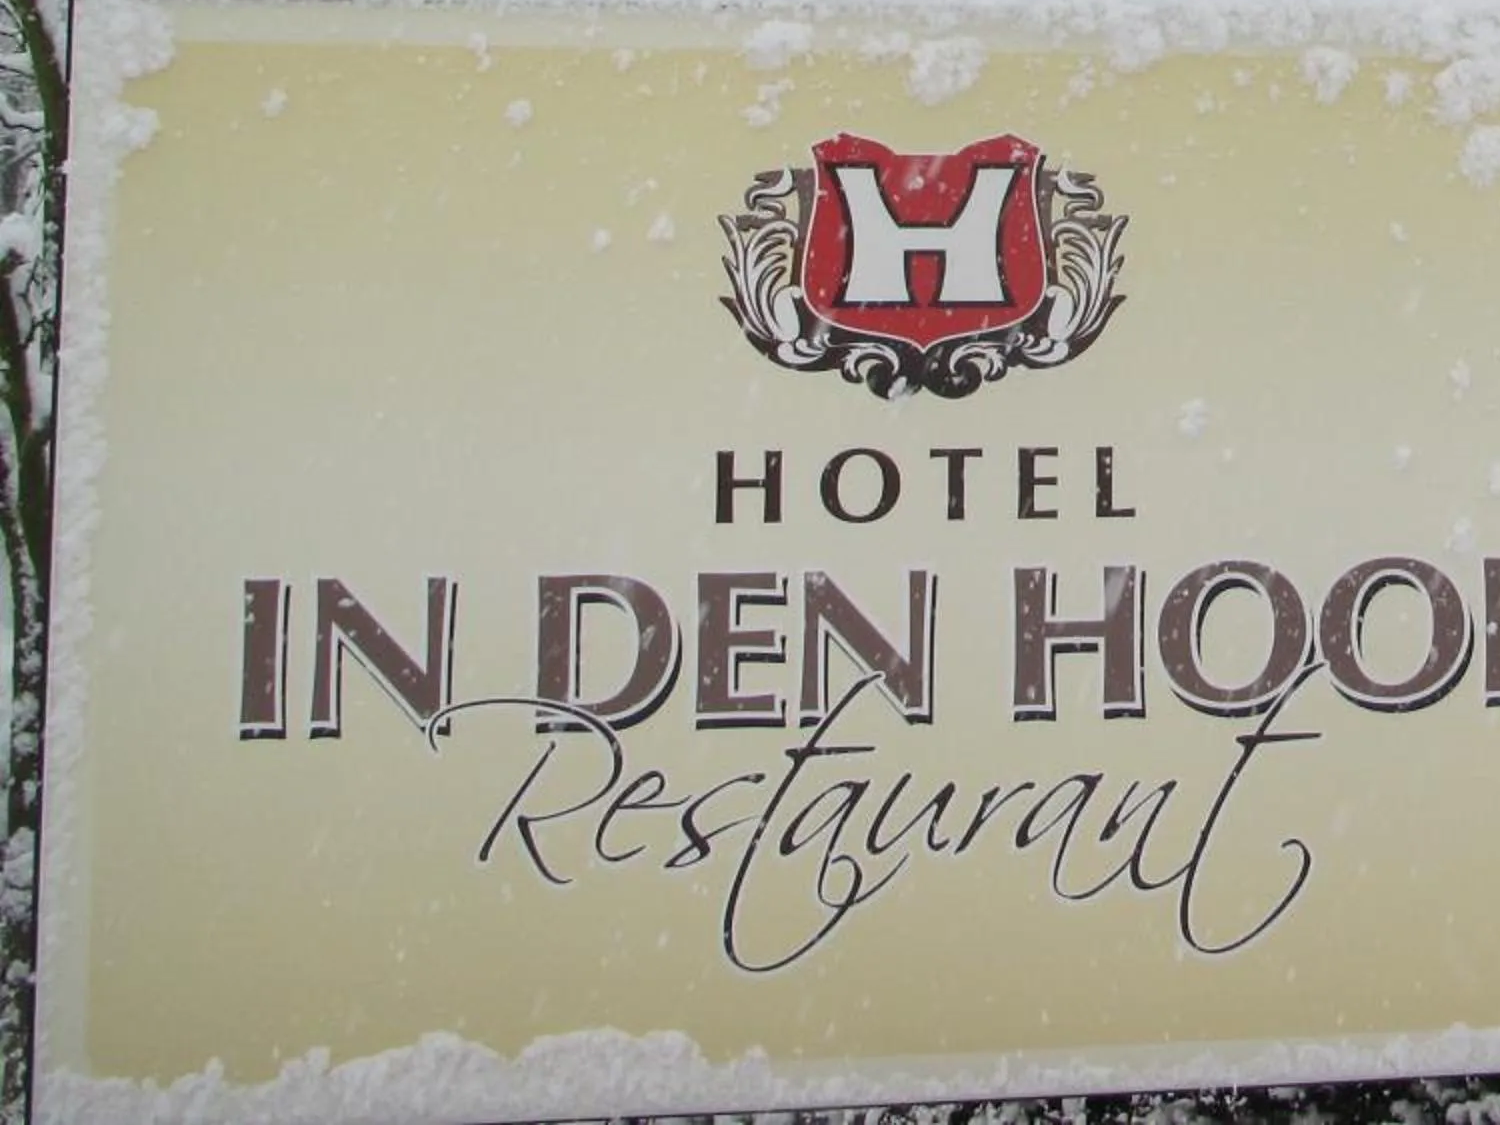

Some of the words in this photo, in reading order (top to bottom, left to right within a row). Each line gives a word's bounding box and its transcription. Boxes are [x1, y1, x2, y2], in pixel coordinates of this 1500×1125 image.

[715, 445, 1137, 525] HOTEL
[239, 575, 462, 741] IN
[535, 568, 941, 735] DEN
[427, 662, 1314, 974] Restaurant
